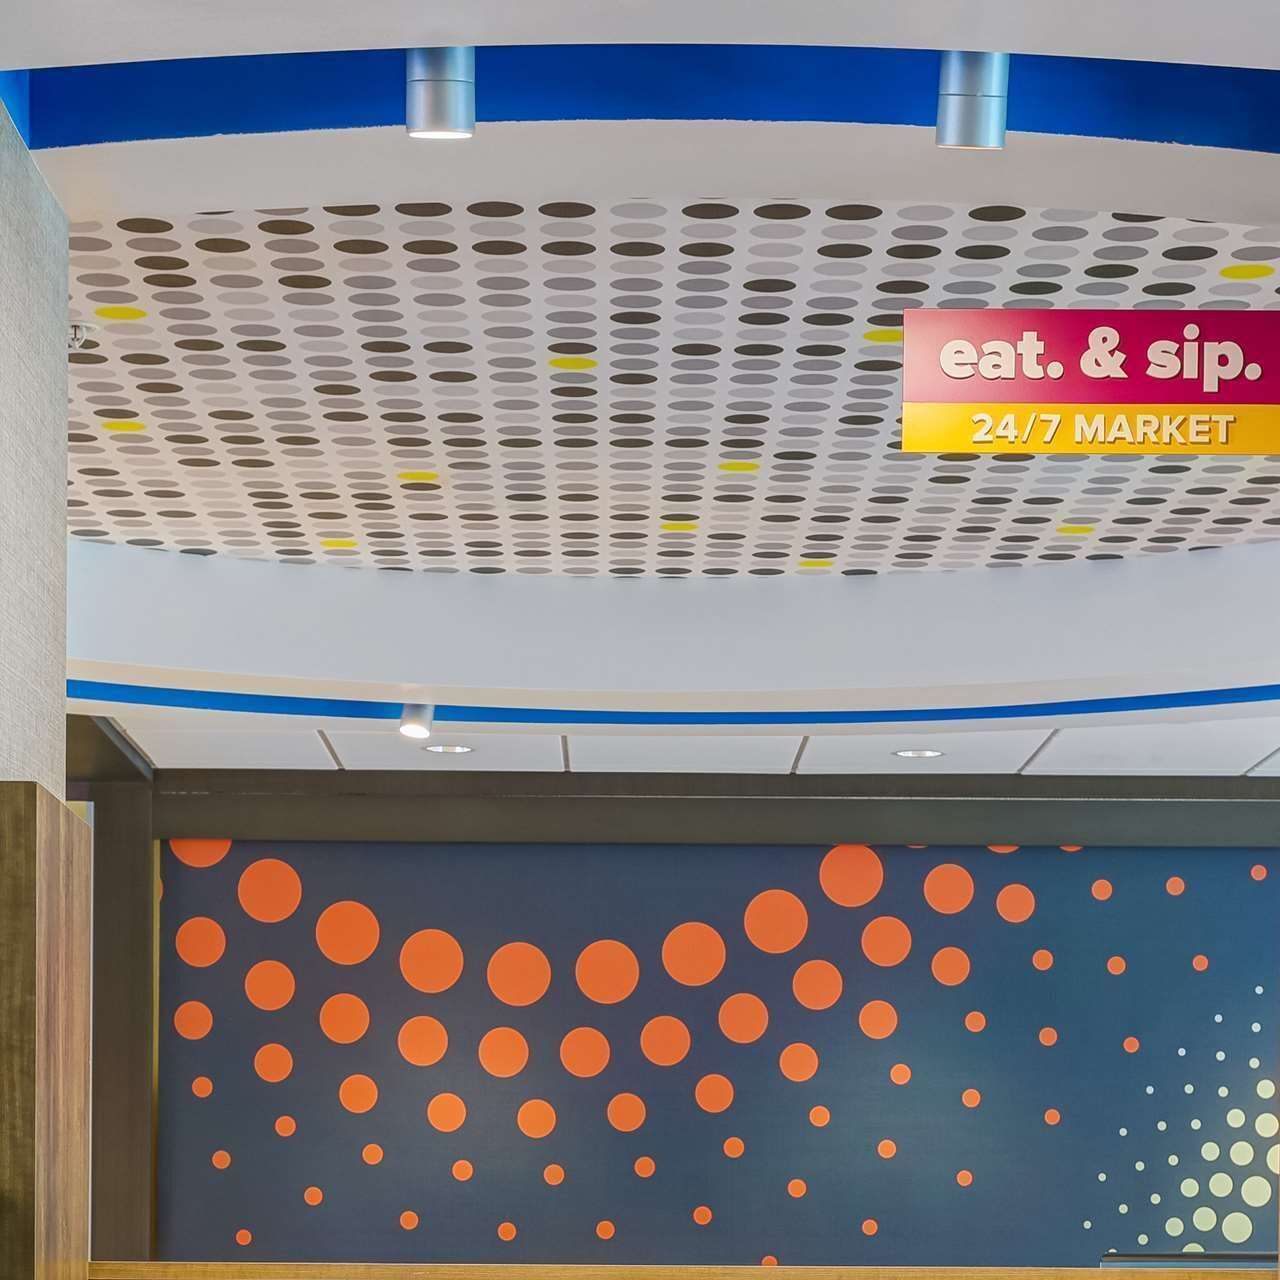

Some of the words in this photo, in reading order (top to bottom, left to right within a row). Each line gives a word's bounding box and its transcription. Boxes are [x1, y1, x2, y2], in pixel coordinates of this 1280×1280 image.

[940, 331, 1064, 380] eat.
[1080, 326, 1128, 379] &
[1146, 324, 1261, 392] sip.
[971, 413, 1061, 444] 24/7
[1075, 414, 1236, 445] MARKET
